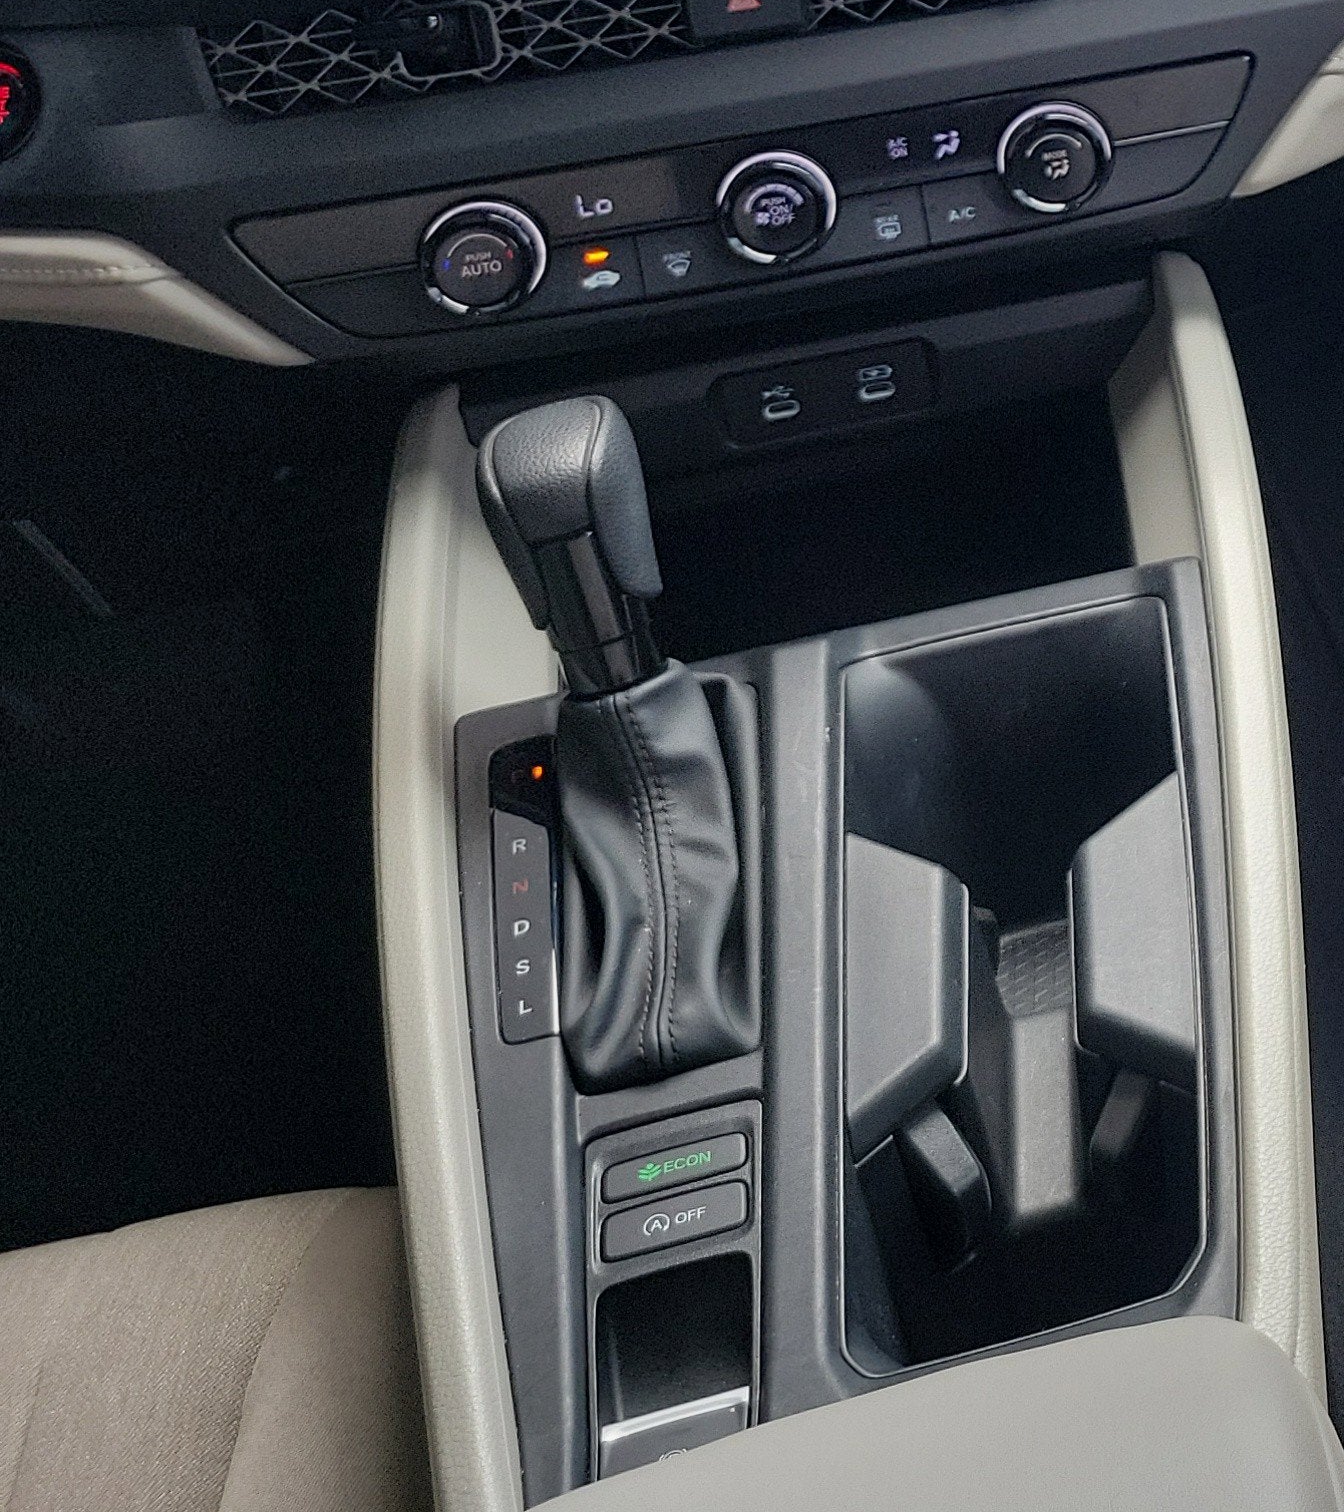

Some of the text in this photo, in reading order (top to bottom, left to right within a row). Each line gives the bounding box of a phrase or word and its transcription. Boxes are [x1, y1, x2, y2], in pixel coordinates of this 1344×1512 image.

[771, 213, 796, 226] OFF
[949, 206, 977, 223] A/C
[465, 250, 493, 263] PUSH
[460, 259, 503, 279] AUTO
[512, 839, 528, 855] R
[512, 878, 529, 895] N
[514, 919, 531, 936] D
[516, 959, 531, 975] S
[518, 1000, 533, 1015] L
[662, 1150, 712, 1174] ECON
[675, 1206, 707, 1224] OFF
